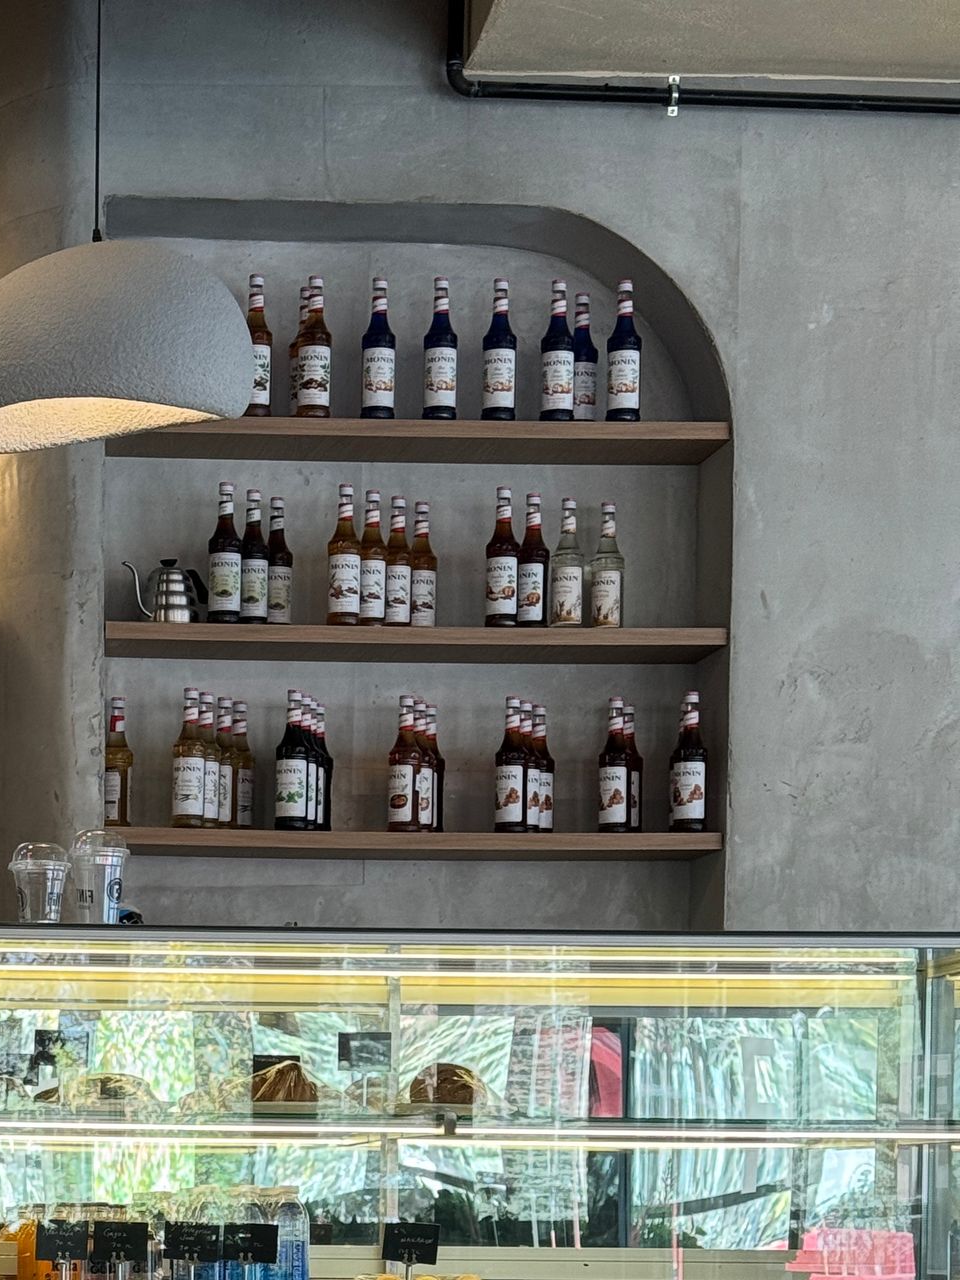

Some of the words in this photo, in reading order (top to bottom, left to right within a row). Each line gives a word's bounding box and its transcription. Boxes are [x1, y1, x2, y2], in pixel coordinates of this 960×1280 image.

[300, 354, 328, 362] MONIN
[484, 357, 513, 365] MONIN
[544, 359, 572, 367] MONIN
[608, 359, 637, 367] MONIN
[212, 560, 239, 568] MONIN
